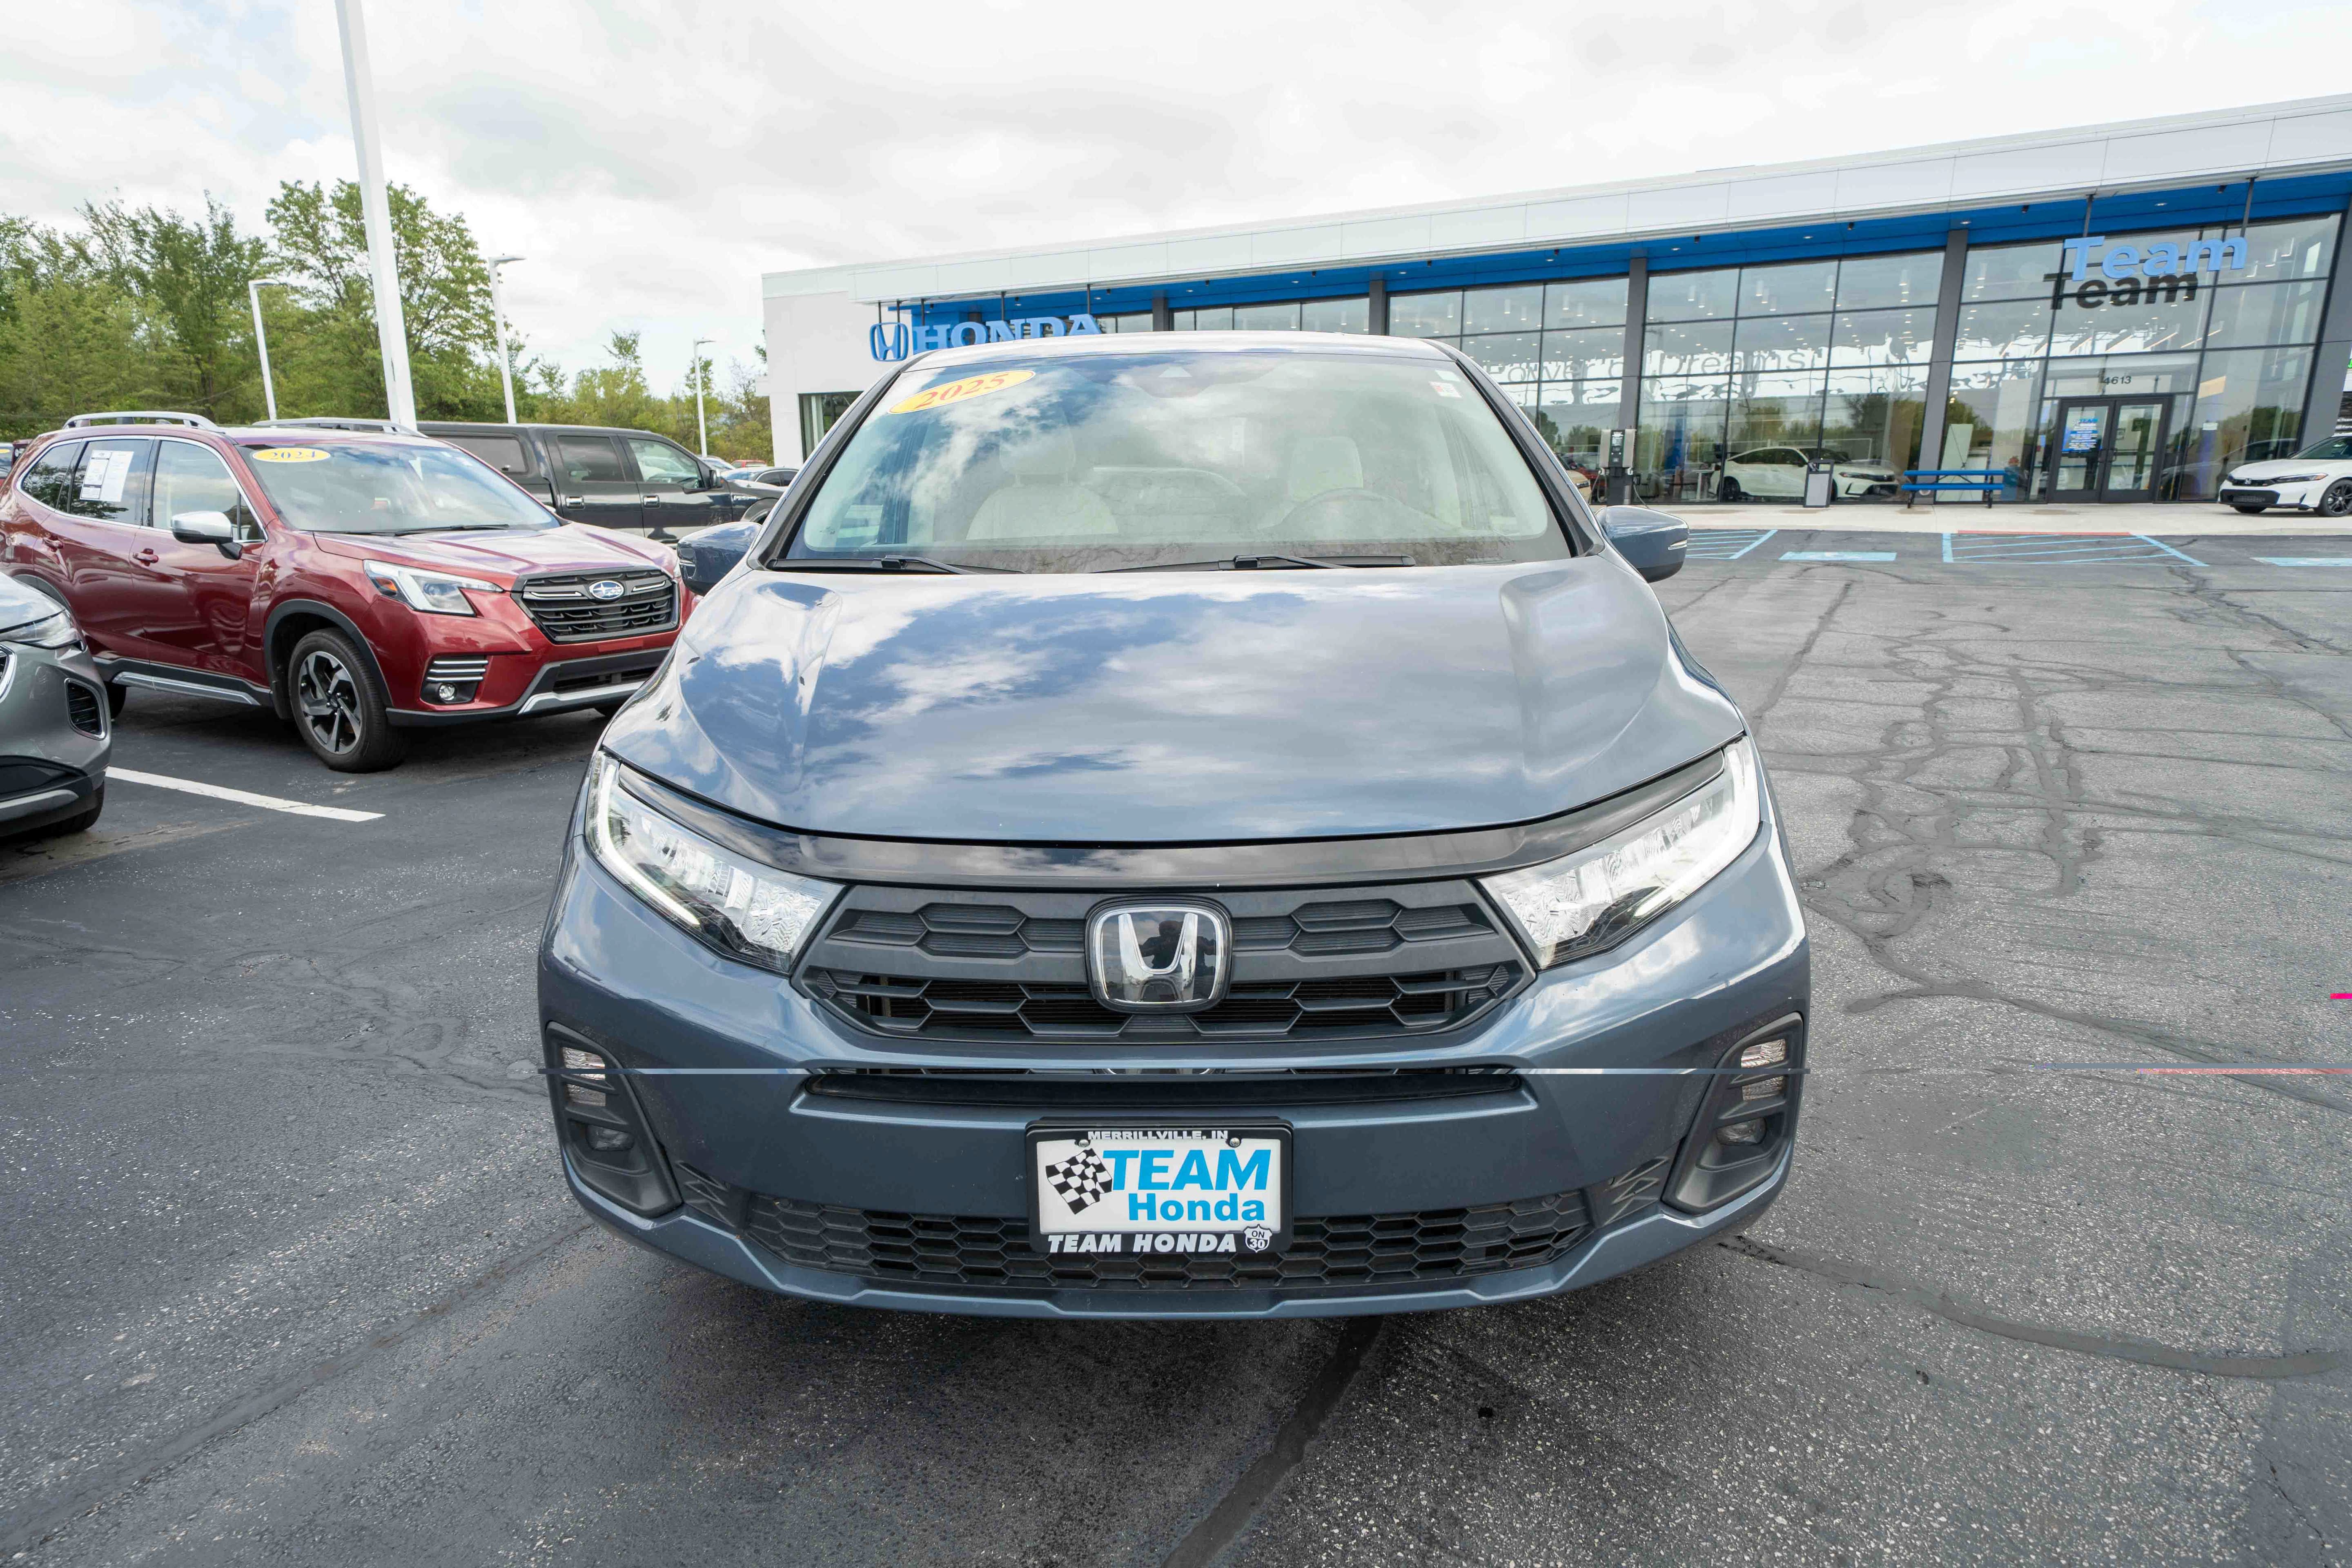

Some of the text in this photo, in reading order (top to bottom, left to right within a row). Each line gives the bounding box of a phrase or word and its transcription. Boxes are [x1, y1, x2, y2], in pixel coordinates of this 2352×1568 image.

[2063, 236, 2248, 281] Team
[2043, 272, 2198, 310] Team
[913, 314, 1102, 355] HONDA
[914, 373, 1009, 409] 2025
[2100, 376, 2131, 385] 4613
[1212, 1131, 1228, 1139] IN
[1103, 1149, 1271, 1190] TEAM
[1128, 1193, 1265, 1221] Honda
[1048, 1233, 1236, 1253] TEAM HONDA
[1249, 1238, 1265, 1249] 30
